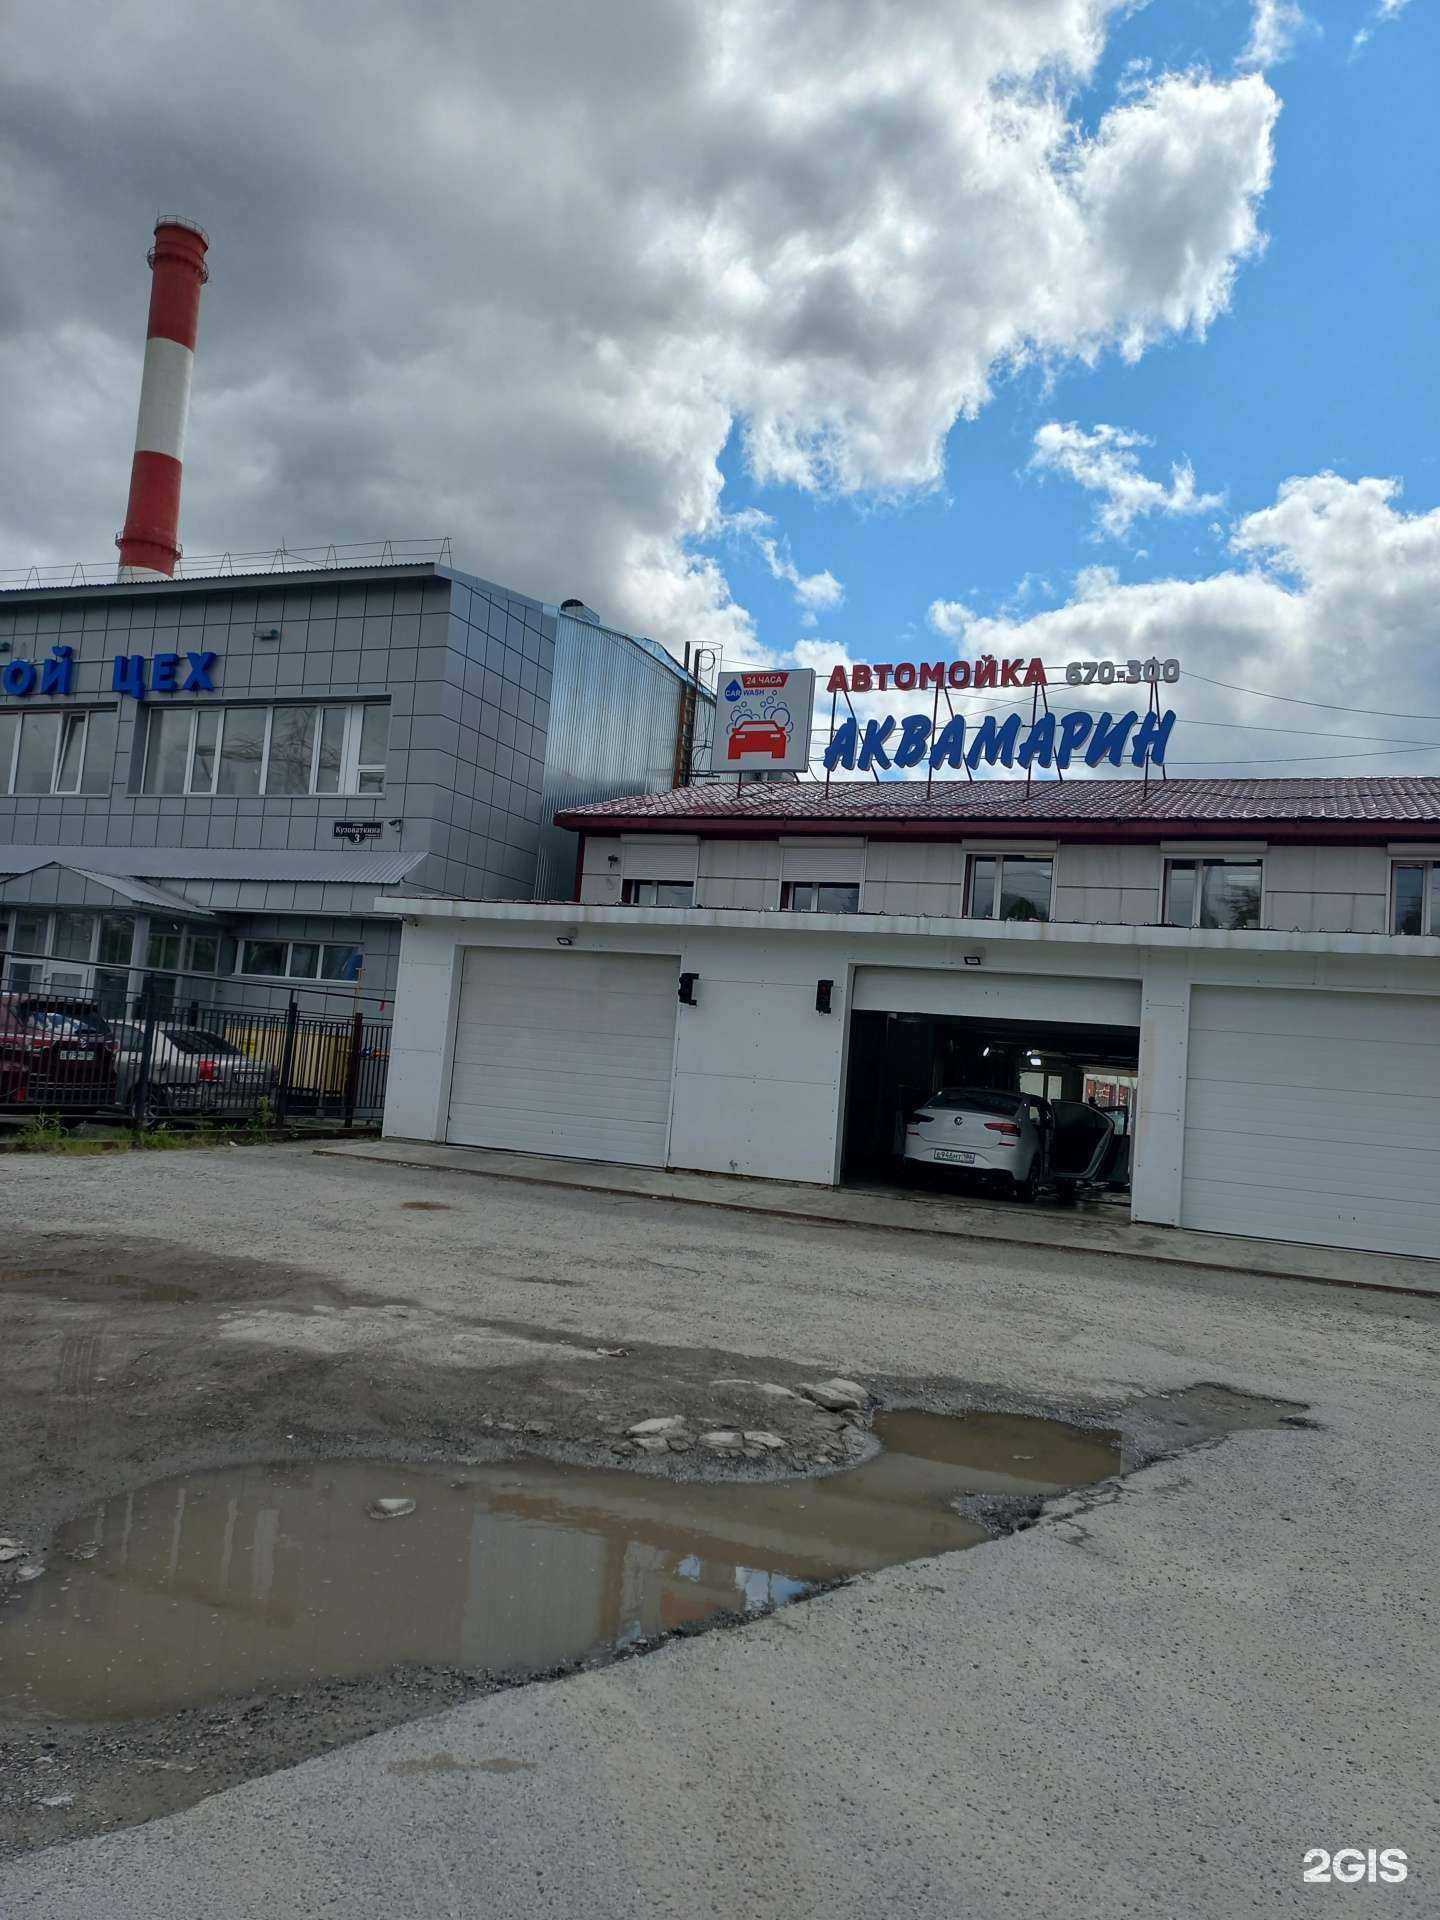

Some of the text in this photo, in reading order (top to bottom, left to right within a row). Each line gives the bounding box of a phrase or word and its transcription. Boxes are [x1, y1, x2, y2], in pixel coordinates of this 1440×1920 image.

[3, 645, 217, 700] ОЙ ЦЕХ
[745, 676, 782, 685] 24 ЧАСА
[826, 654, 1048, 693] АВТОМОЙКА
[1065, 658, 1181, 686] 670-300
[725, 688, 765, 697] CAR WASH
[822, 709, 1177, 772] АКВАМАРИН
[354, 834, 360, 843] 3
